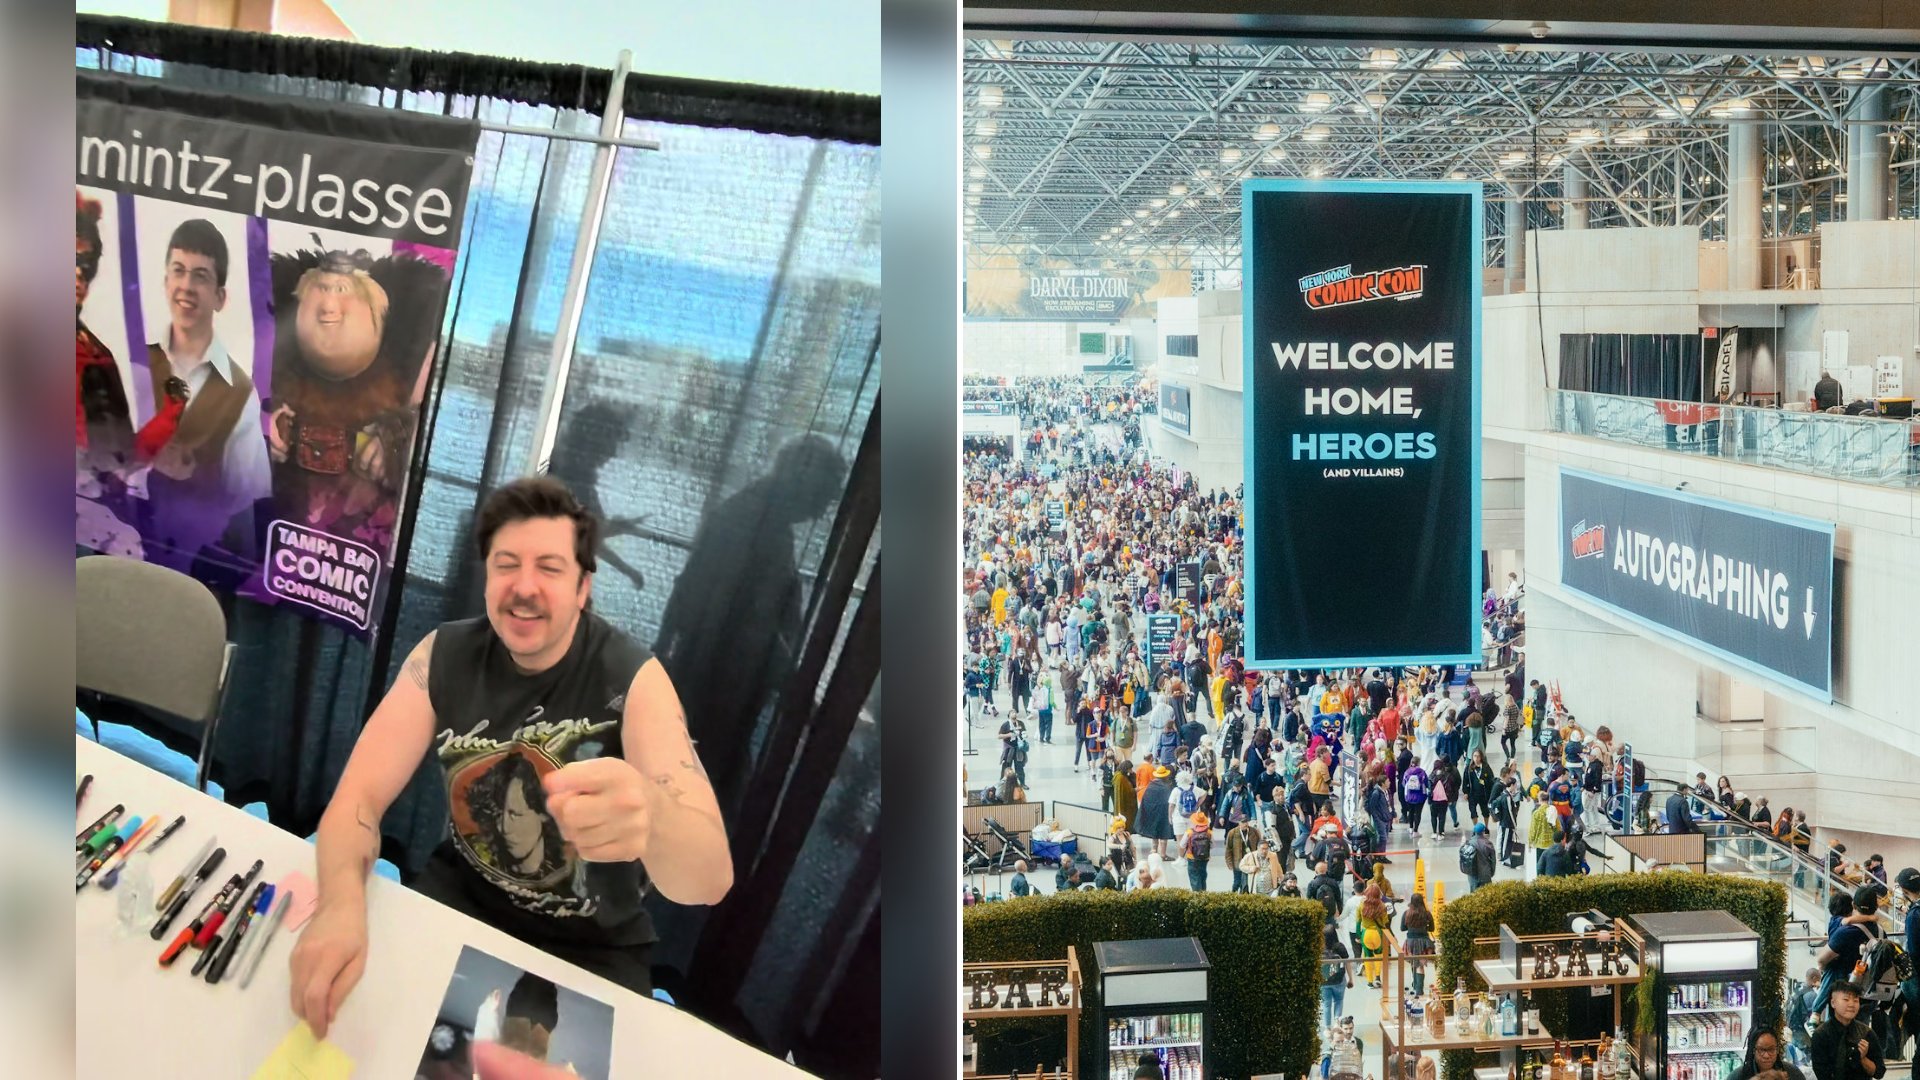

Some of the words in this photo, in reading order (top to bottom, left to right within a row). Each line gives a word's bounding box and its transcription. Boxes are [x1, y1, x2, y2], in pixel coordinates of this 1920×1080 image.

[80, 130, 453, 236] mintz-plasse
[1030, 276, 1080, 298] DARYL
[1082, 276, 1129, 298] DIXON
[1301, 273, 1323, 290] NEW
[1323, 267, 1351, 283] YORK
[1308, 273, 1377, 307] COMIC
[1377, 266, 1421, 296] CON
[1271, 341, 1455, 371] WELCOME
[1720, 340, 1732, 396] CITADEL
[1304, 387, 1423, 419] HOME,
[1292, 432, 1437, 461] HEROES
[1323, 467, 1351, 478] (AND
[1352, 467, 1405, 478] VILLAINS)
[278, 526, 339, 561] TAMPA
[344, 547, 375, 573] BAY
[275, 548, 370, 600] COMIC
[1613, 525, 1789, 630] AUTOGRAPHING
[272, 575, 366, 621] CONVENTION
[1531, 940, 1630, 980] BAR
[967, 968, 1071, 1010] BAR
